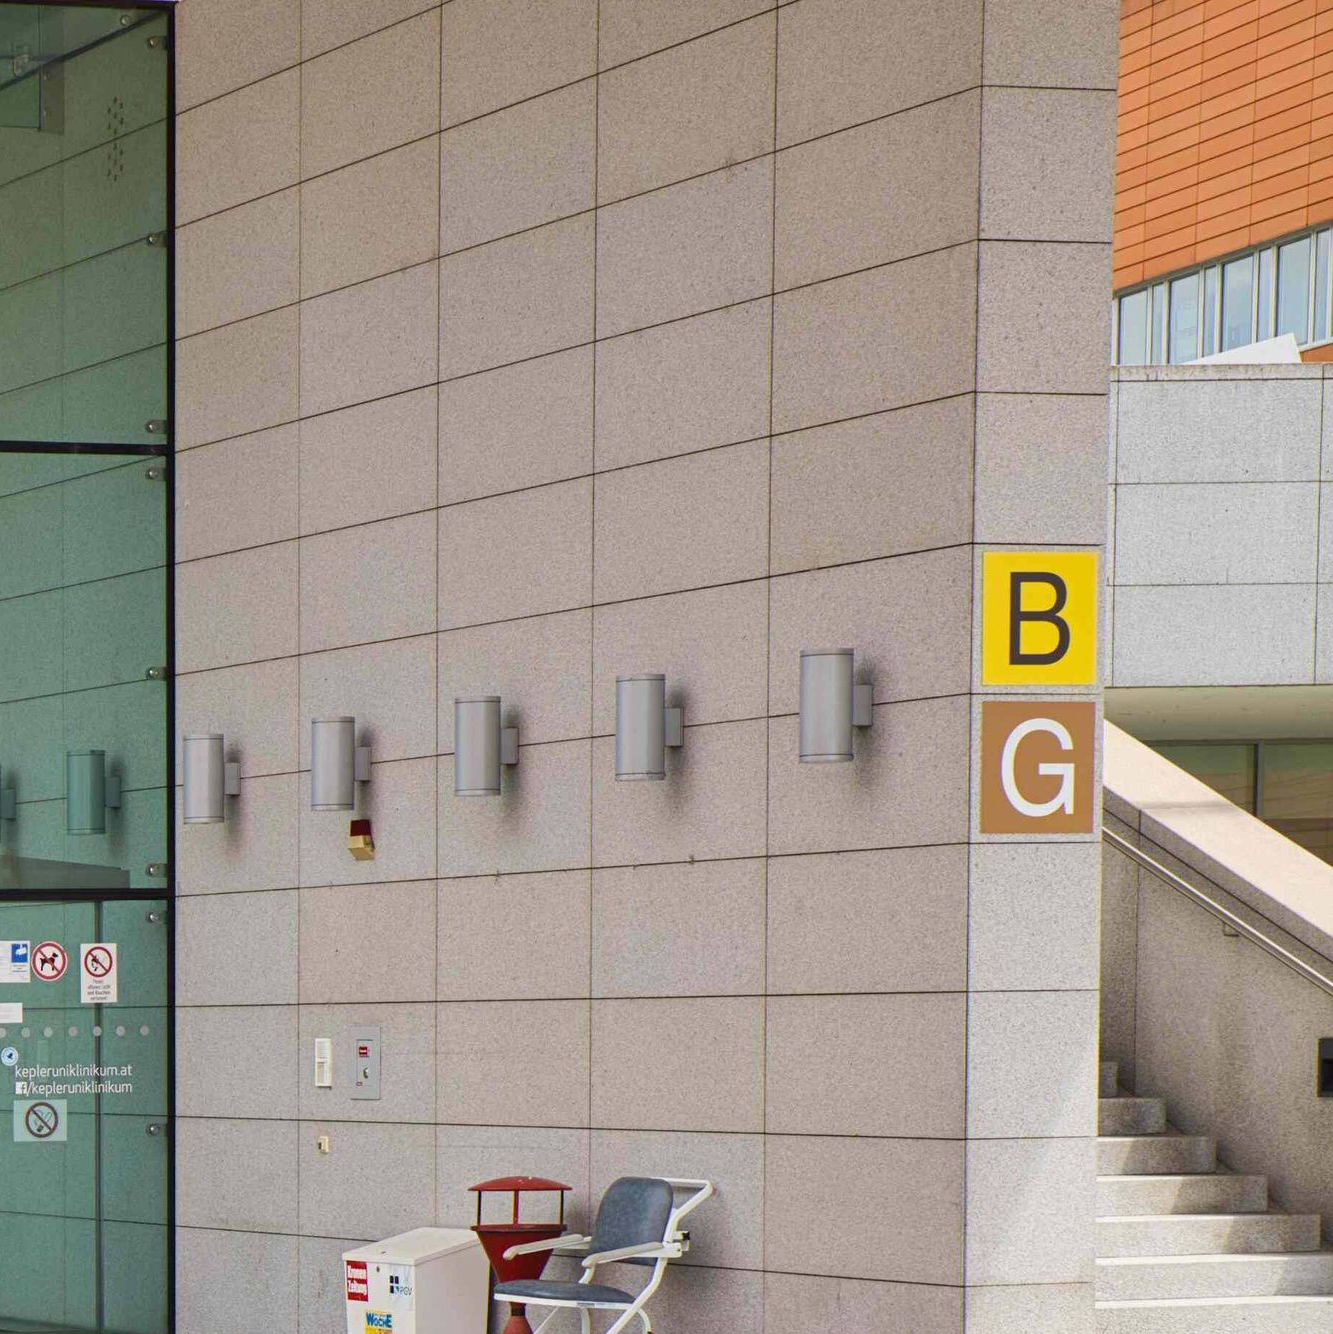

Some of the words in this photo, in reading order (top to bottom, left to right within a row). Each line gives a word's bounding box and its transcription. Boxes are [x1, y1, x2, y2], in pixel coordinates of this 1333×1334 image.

[1009, 571, 1071, 666] B
[1001, 717, 1076, 817] G
[15, 1064, 133, 1080] kepleruniklinikum.at
